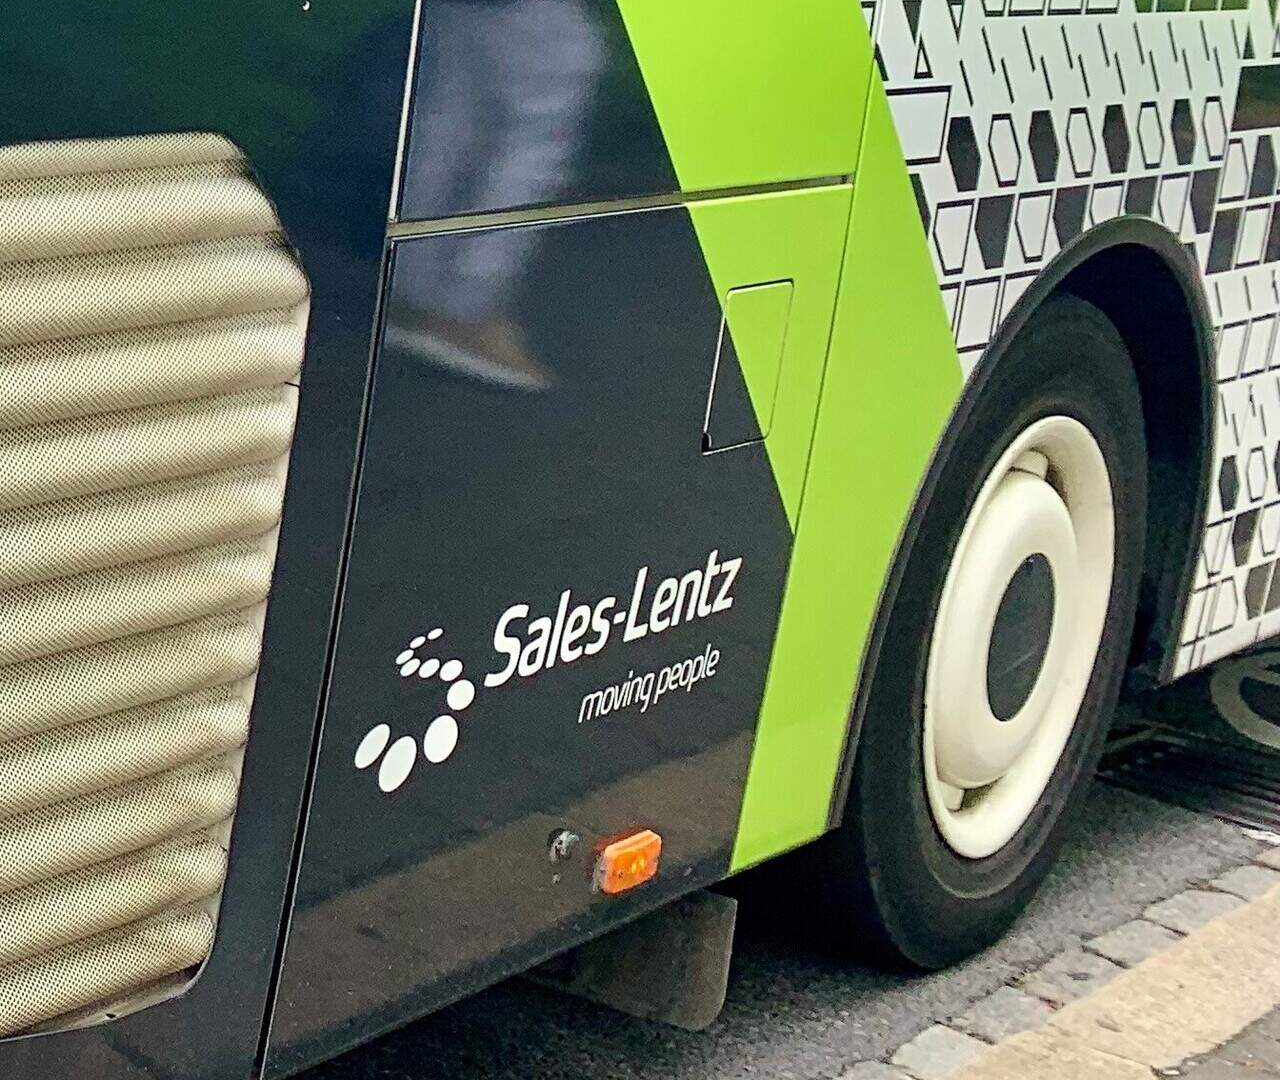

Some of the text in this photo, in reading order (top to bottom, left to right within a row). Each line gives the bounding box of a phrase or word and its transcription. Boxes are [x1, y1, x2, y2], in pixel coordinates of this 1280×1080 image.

[484, 549, 742, 688] Sales-Lentz
[577, 643, 721, 723] moving people
